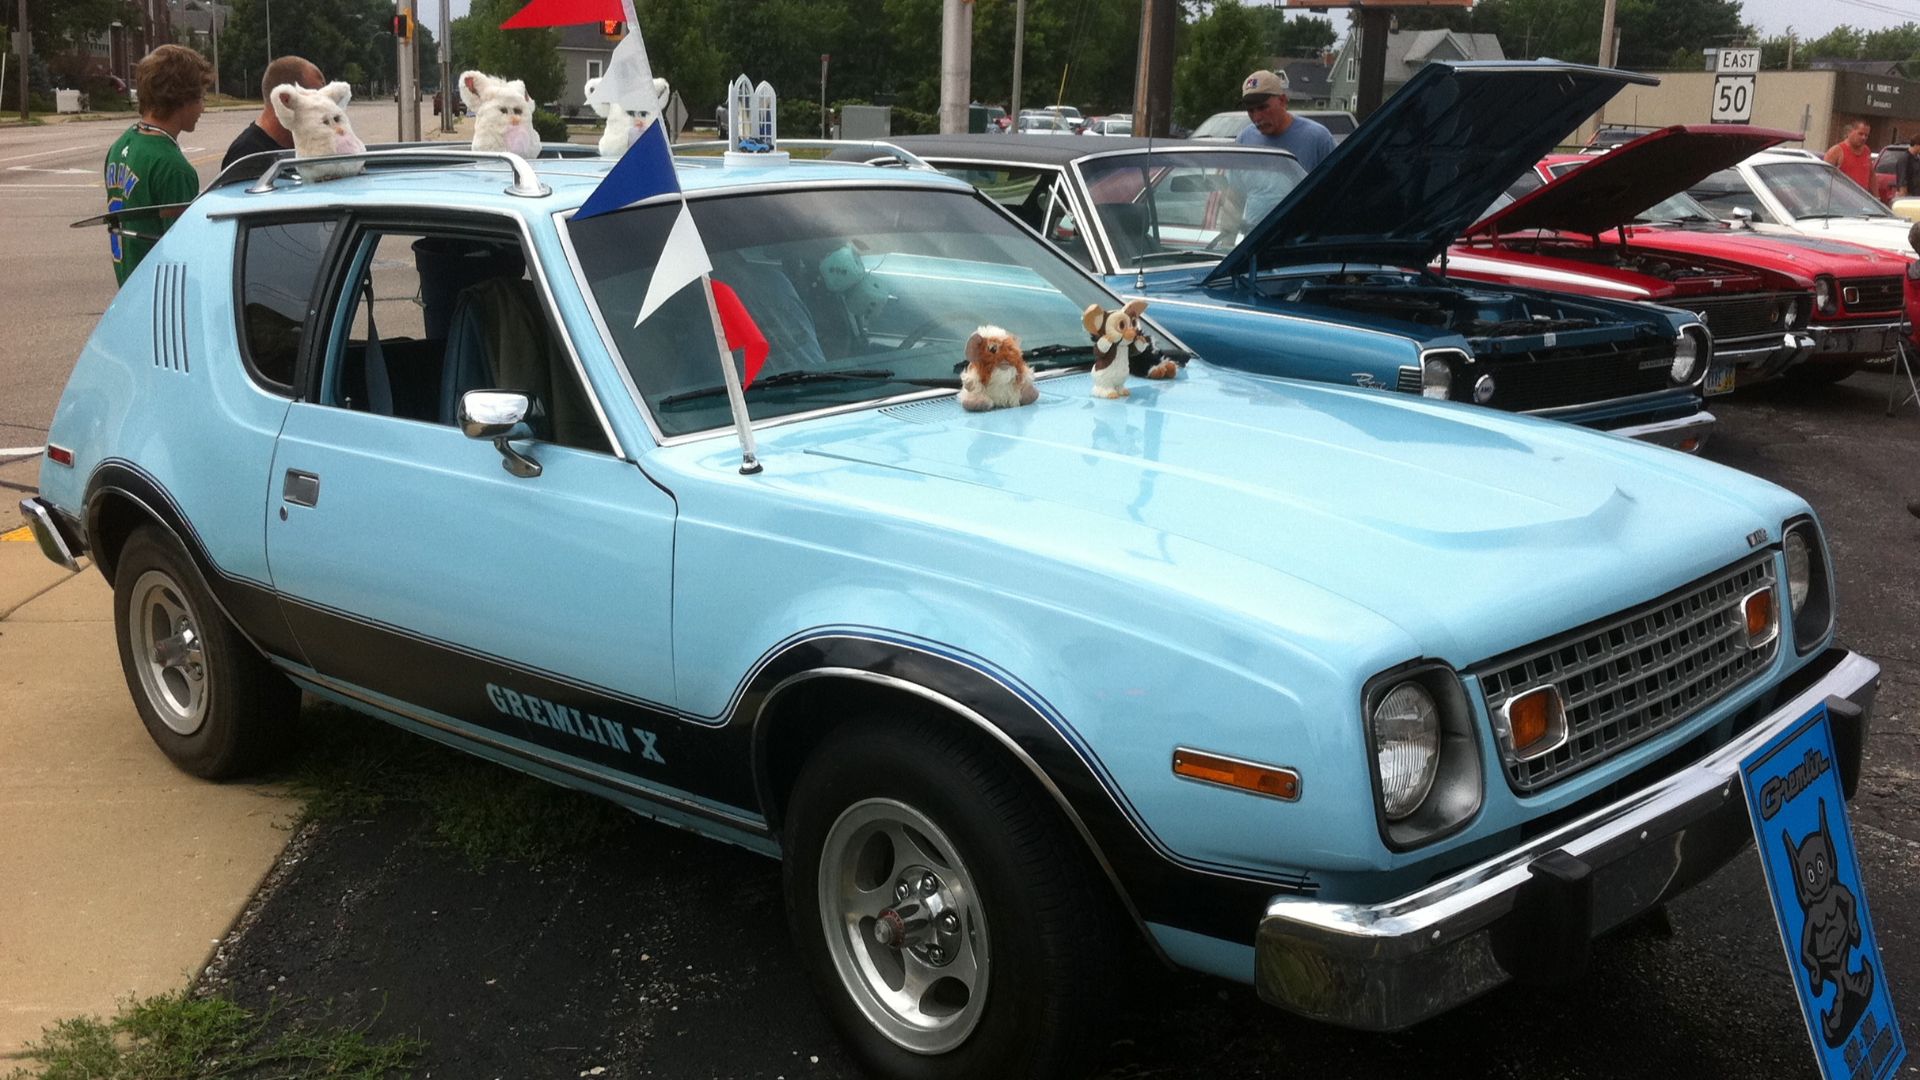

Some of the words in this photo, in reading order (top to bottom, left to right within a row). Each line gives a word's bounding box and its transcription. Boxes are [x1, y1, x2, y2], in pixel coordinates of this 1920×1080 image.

[1722, 51, 1755, 69] EAST
[1718, 84, 1748, 113] 50
[485, 682, 631, 754] GREMLIN
[631, 726, 667, 765] X
[1759, 748, 1831, 822] Gremlin
